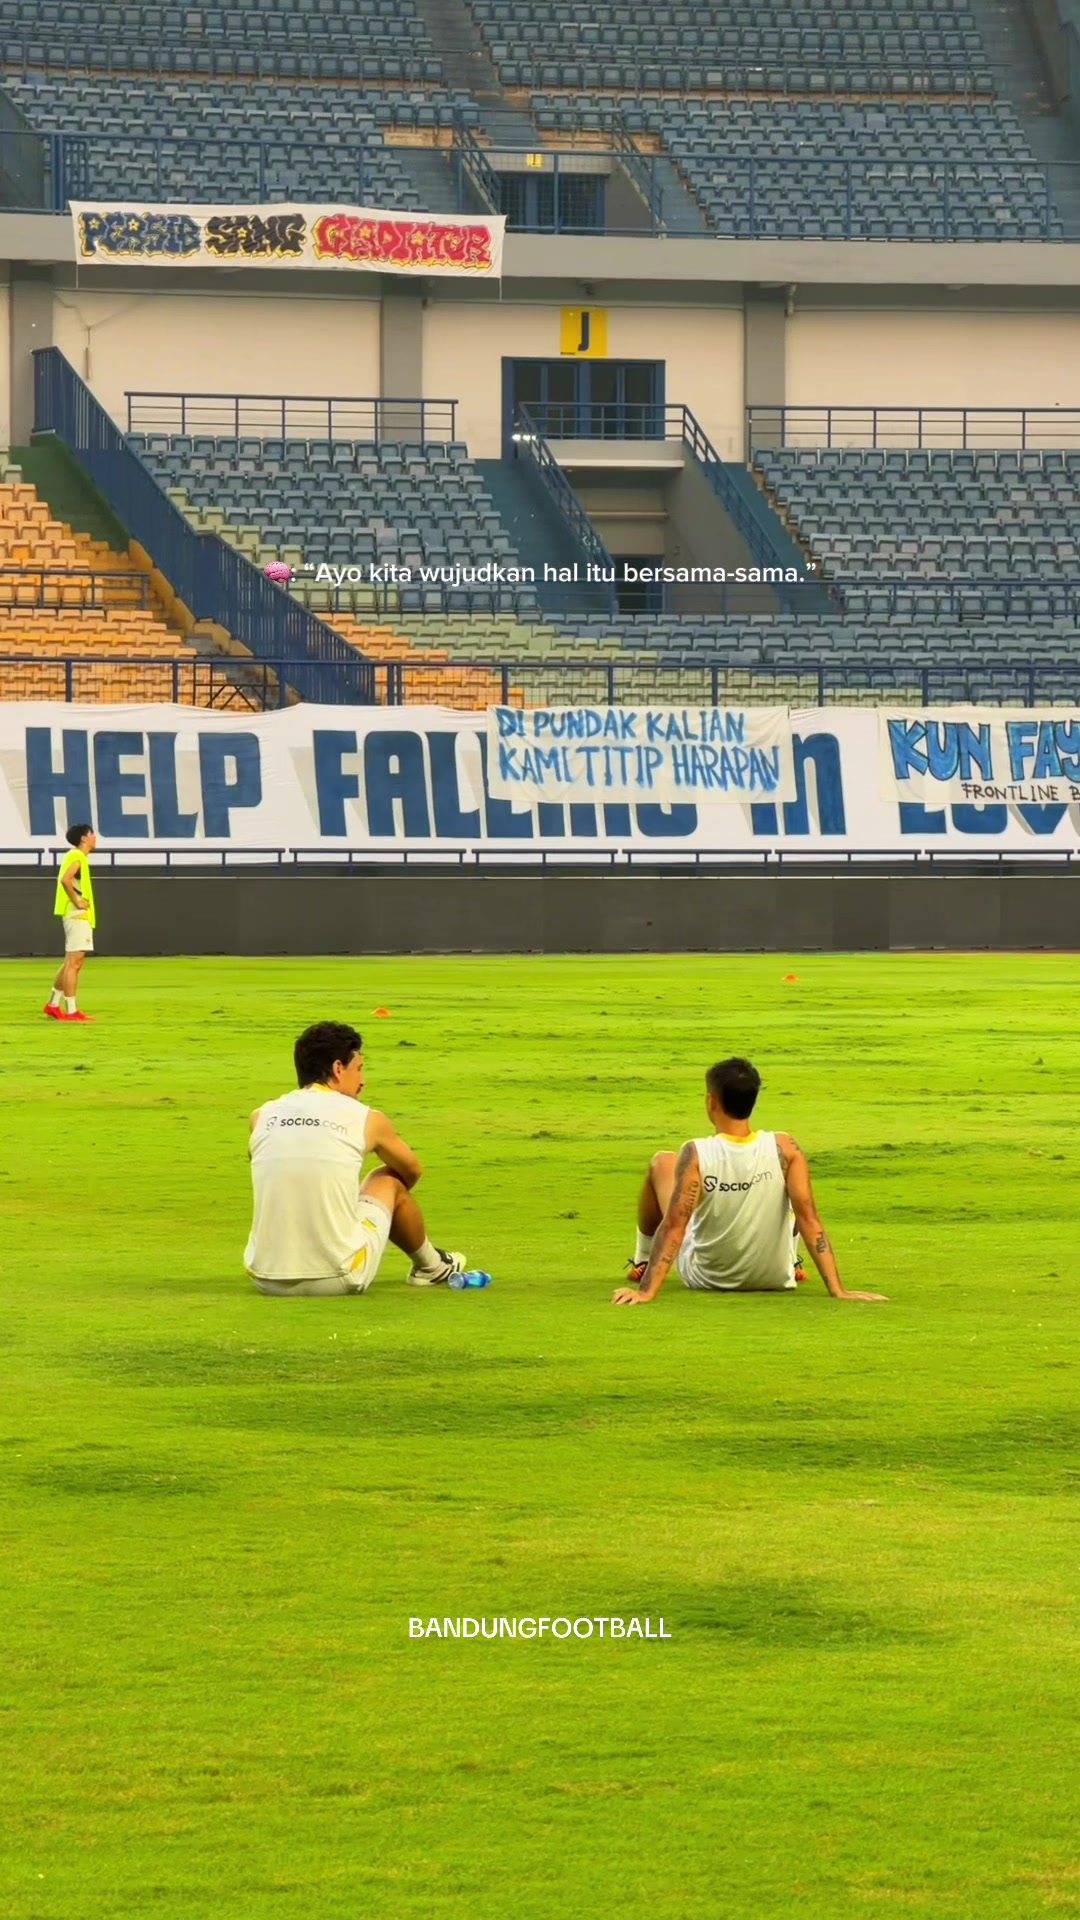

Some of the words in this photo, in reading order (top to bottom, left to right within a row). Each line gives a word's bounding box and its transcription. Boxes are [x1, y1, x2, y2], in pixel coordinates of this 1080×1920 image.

[79, 211, 201, 257] PERSIB
[204, 213, 306, 258] SANG
[312, 213, 492, 269] GLADIATOR
[577, 311, 590, 352] J
[496, 708, 527, 737] DI
[534, 709, 637, 739] PUNDAK
[646, 709, 745, 742] KALIAN
[887, 719, 994, 781] KUN
[26, 727, 262, 838] HELP
[499, 742, 575, 784] KAMI
[575, 746, 664, 789] TITIP
[671, 745, 780, 792] HARAPAN
[961, 783, 1060, 803] FRONTLINE
